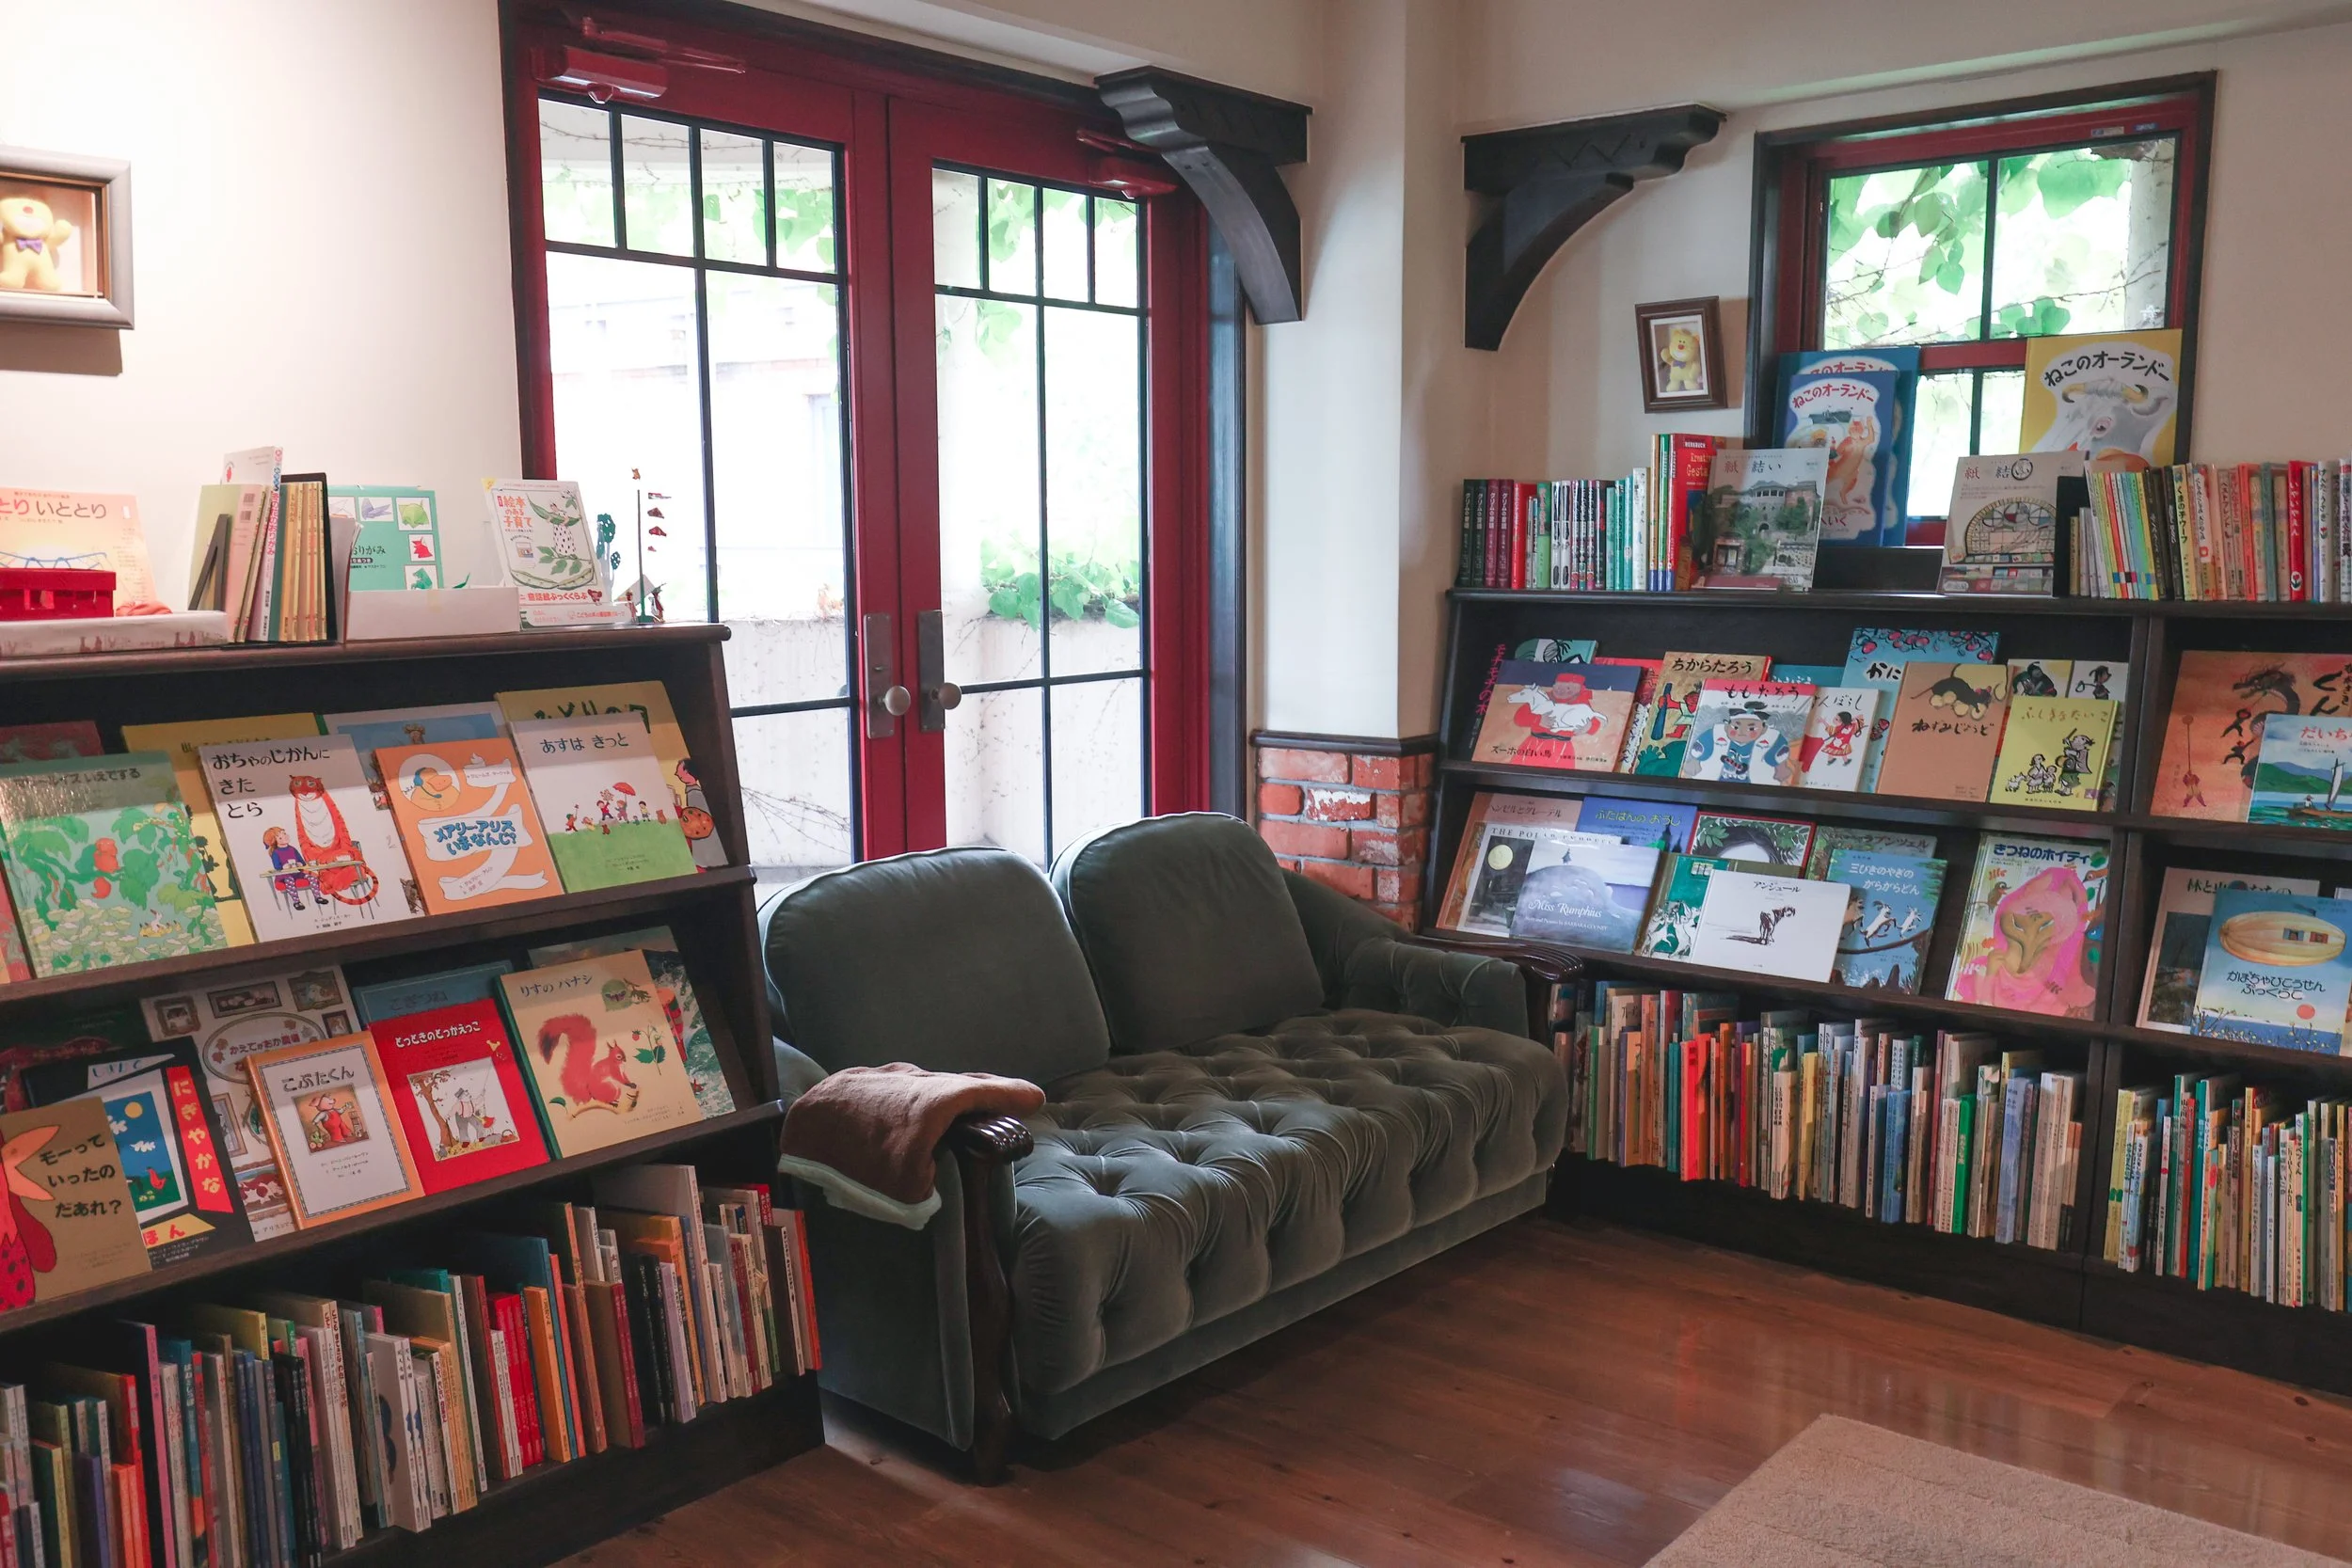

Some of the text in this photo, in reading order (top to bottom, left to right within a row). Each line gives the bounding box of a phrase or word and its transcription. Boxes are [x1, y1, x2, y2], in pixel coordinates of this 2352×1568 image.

[2044, 351, 2170, 388] ねこのオーランドー
[1792, 383, 1874, 408] ねこのオーランドー
[36, 500, 106, 518] いととり
[503, 496, 526, 508] 絵本
[504, 516, 532, 528] 子育て
[1672, 658, 1753, 674] ちからたろう
[1724, 685, 1799, 701] ももたろう
[540, 732, 628, 753] あすは きっと
[213, 747, 330, 770] おちゃのじかんに
[1491, 746, 1551, 758] スーホの白い馬
[218, 778, 255, 795] きた
[227, 801, 262, 818] とら
[1492, 827, 1513, 835] THE
[1994, 844, 2090, 863] きつねのホイティ
[1850, 863, 1914, 878] 三びきのやぎの
[1754, 880, 1801, 893] アンジュール
[1864, 879, 1919, 895] がらがらどん
[1529, 898, 1602, 918] Miss Rumphius
[2227, 970, 2326, 992] かぼちゃひこうせん
[519, 983, 554, 998] りすの
[2241, 983, 2302, 1000] ぷっくらこ
[394, 1021, 481, 1048] とっときのとっかえっこ
[281, 1066, 355, 1093] こぶたくん
[173, 1080, 221, 1195] にぎやかな
[40, 1133, 105, 1166] モーって
[47, 1164, 115, 1187] いったの
[55, 1200, 121, 1218] だあれ？
[142, 1224, 185, 1244] ほん
